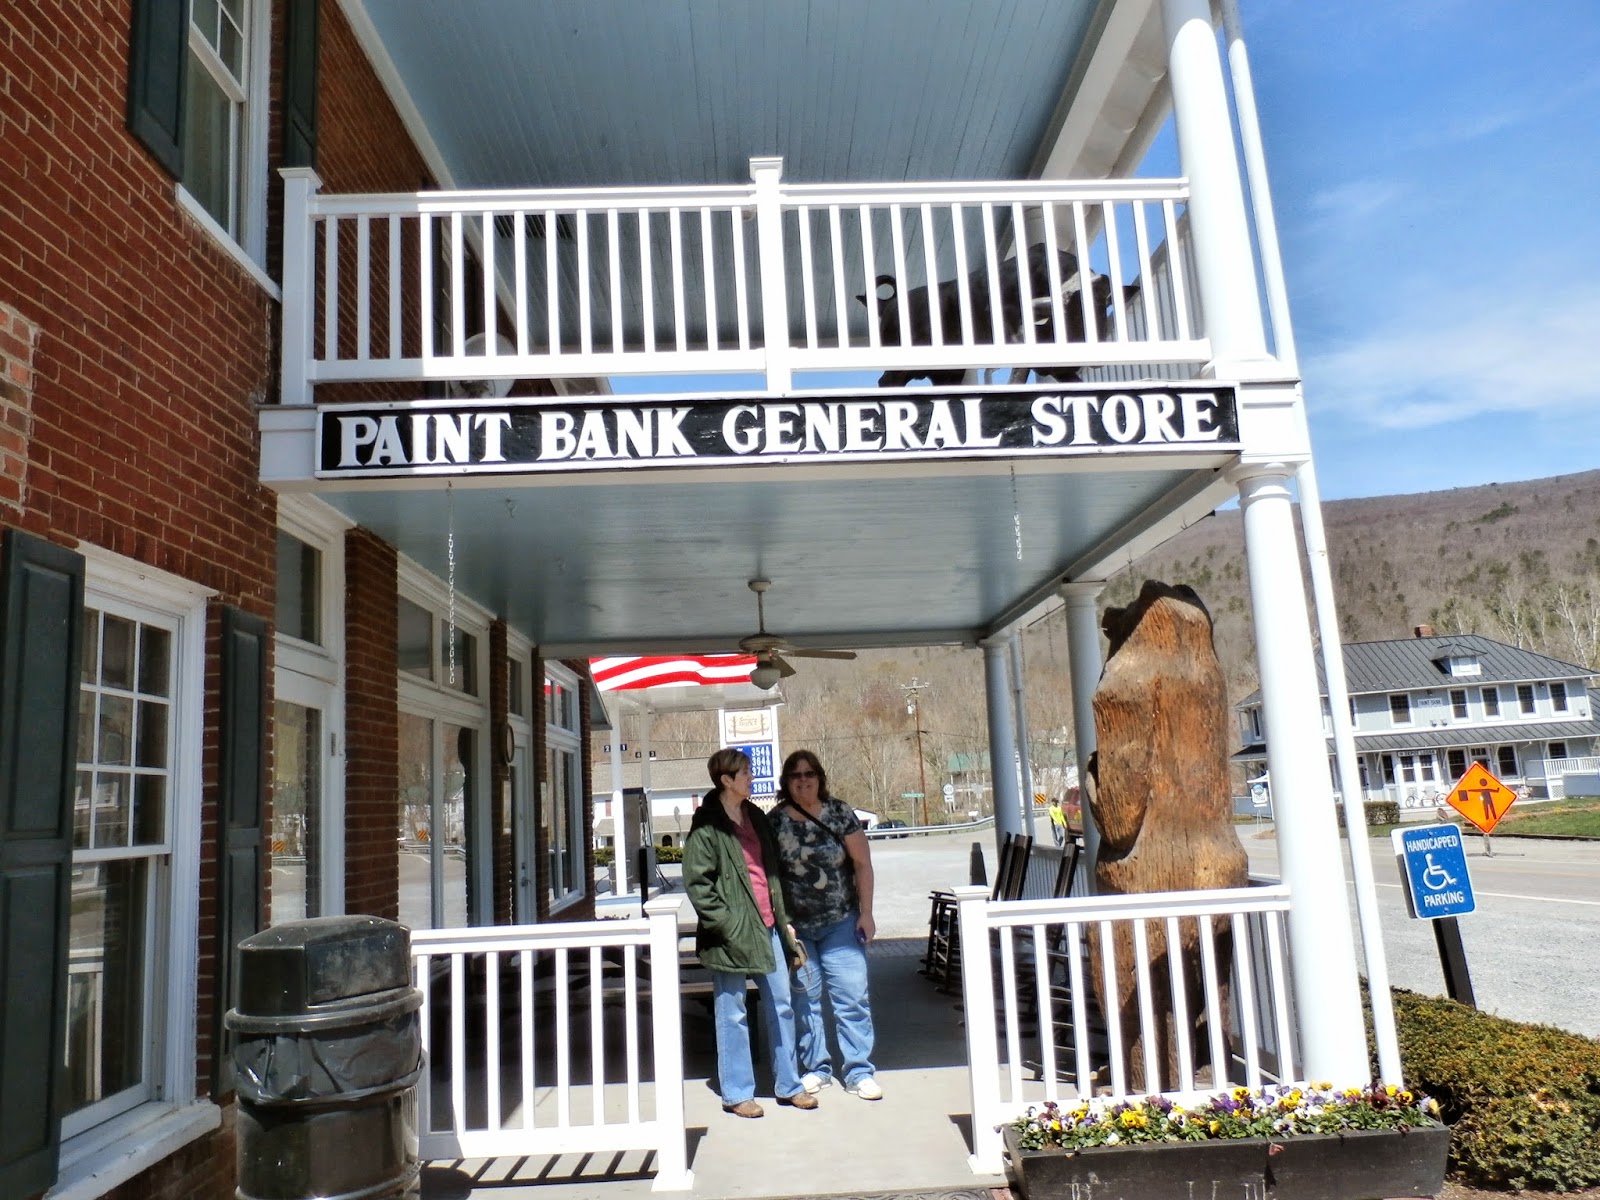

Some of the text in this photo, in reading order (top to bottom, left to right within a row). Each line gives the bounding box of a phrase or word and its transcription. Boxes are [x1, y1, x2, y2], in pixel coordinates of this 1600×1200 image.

[336, 392, 1222, 468] PAINT BANK GENERAL STORE
[1406, 835, 1458, 853] HANDICAPPED
[1423, 891, 1464, 907] PARKING
